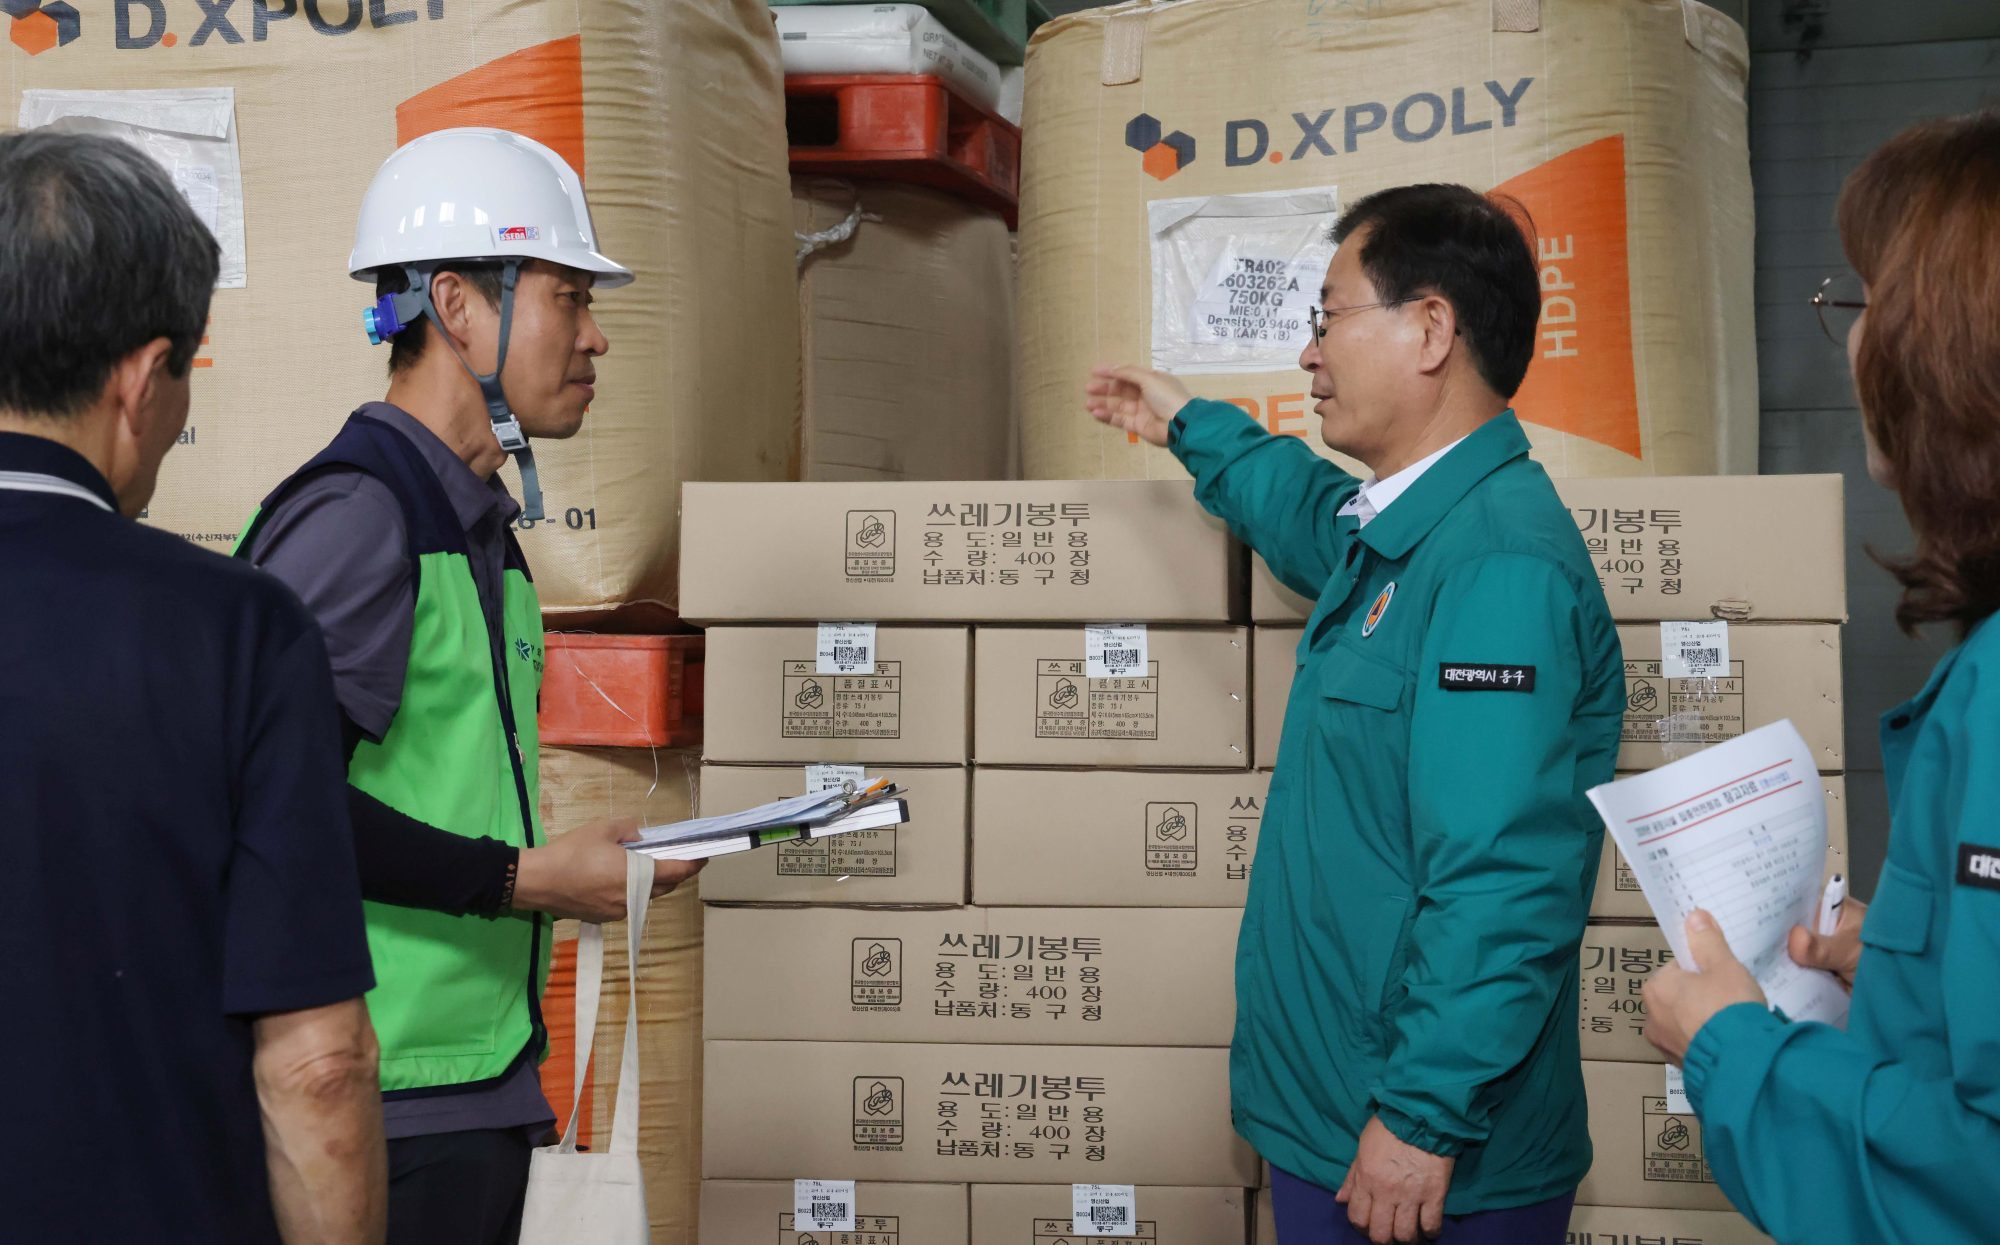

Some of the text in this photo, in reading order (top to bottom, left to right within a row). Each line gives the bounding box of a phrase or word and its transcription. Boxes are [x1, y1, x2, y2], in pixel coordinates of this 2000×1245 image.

[1225, 77, 1535, 167] D.XPOLY
[1229, 290, 1283, 306] 750KG
[1538, 235, 1578, 358] HDPE
[926, 503, 1090, 527] 쓰레기봉투
[1578, 508, 1682, 534] 기봉투
[1014, 552, 1055, 565] 400
[1070, 550, 1091, 567] 장
[1600, 559, 1683, 576] 400 장
[1445, 668, 1524, 686] 대전광역시 동구
[938, 933, 1102, 962] 쓰레기봉투
[1026, 985, 1067, 1000] 400
[1081, 985, 1102, 1003] 장
[940, 1072, 1106, 1101] 쓰레기봉투
[1029, 1125, 1070, 1140] 400
[1084, 1125, 1106, 1142] 장
